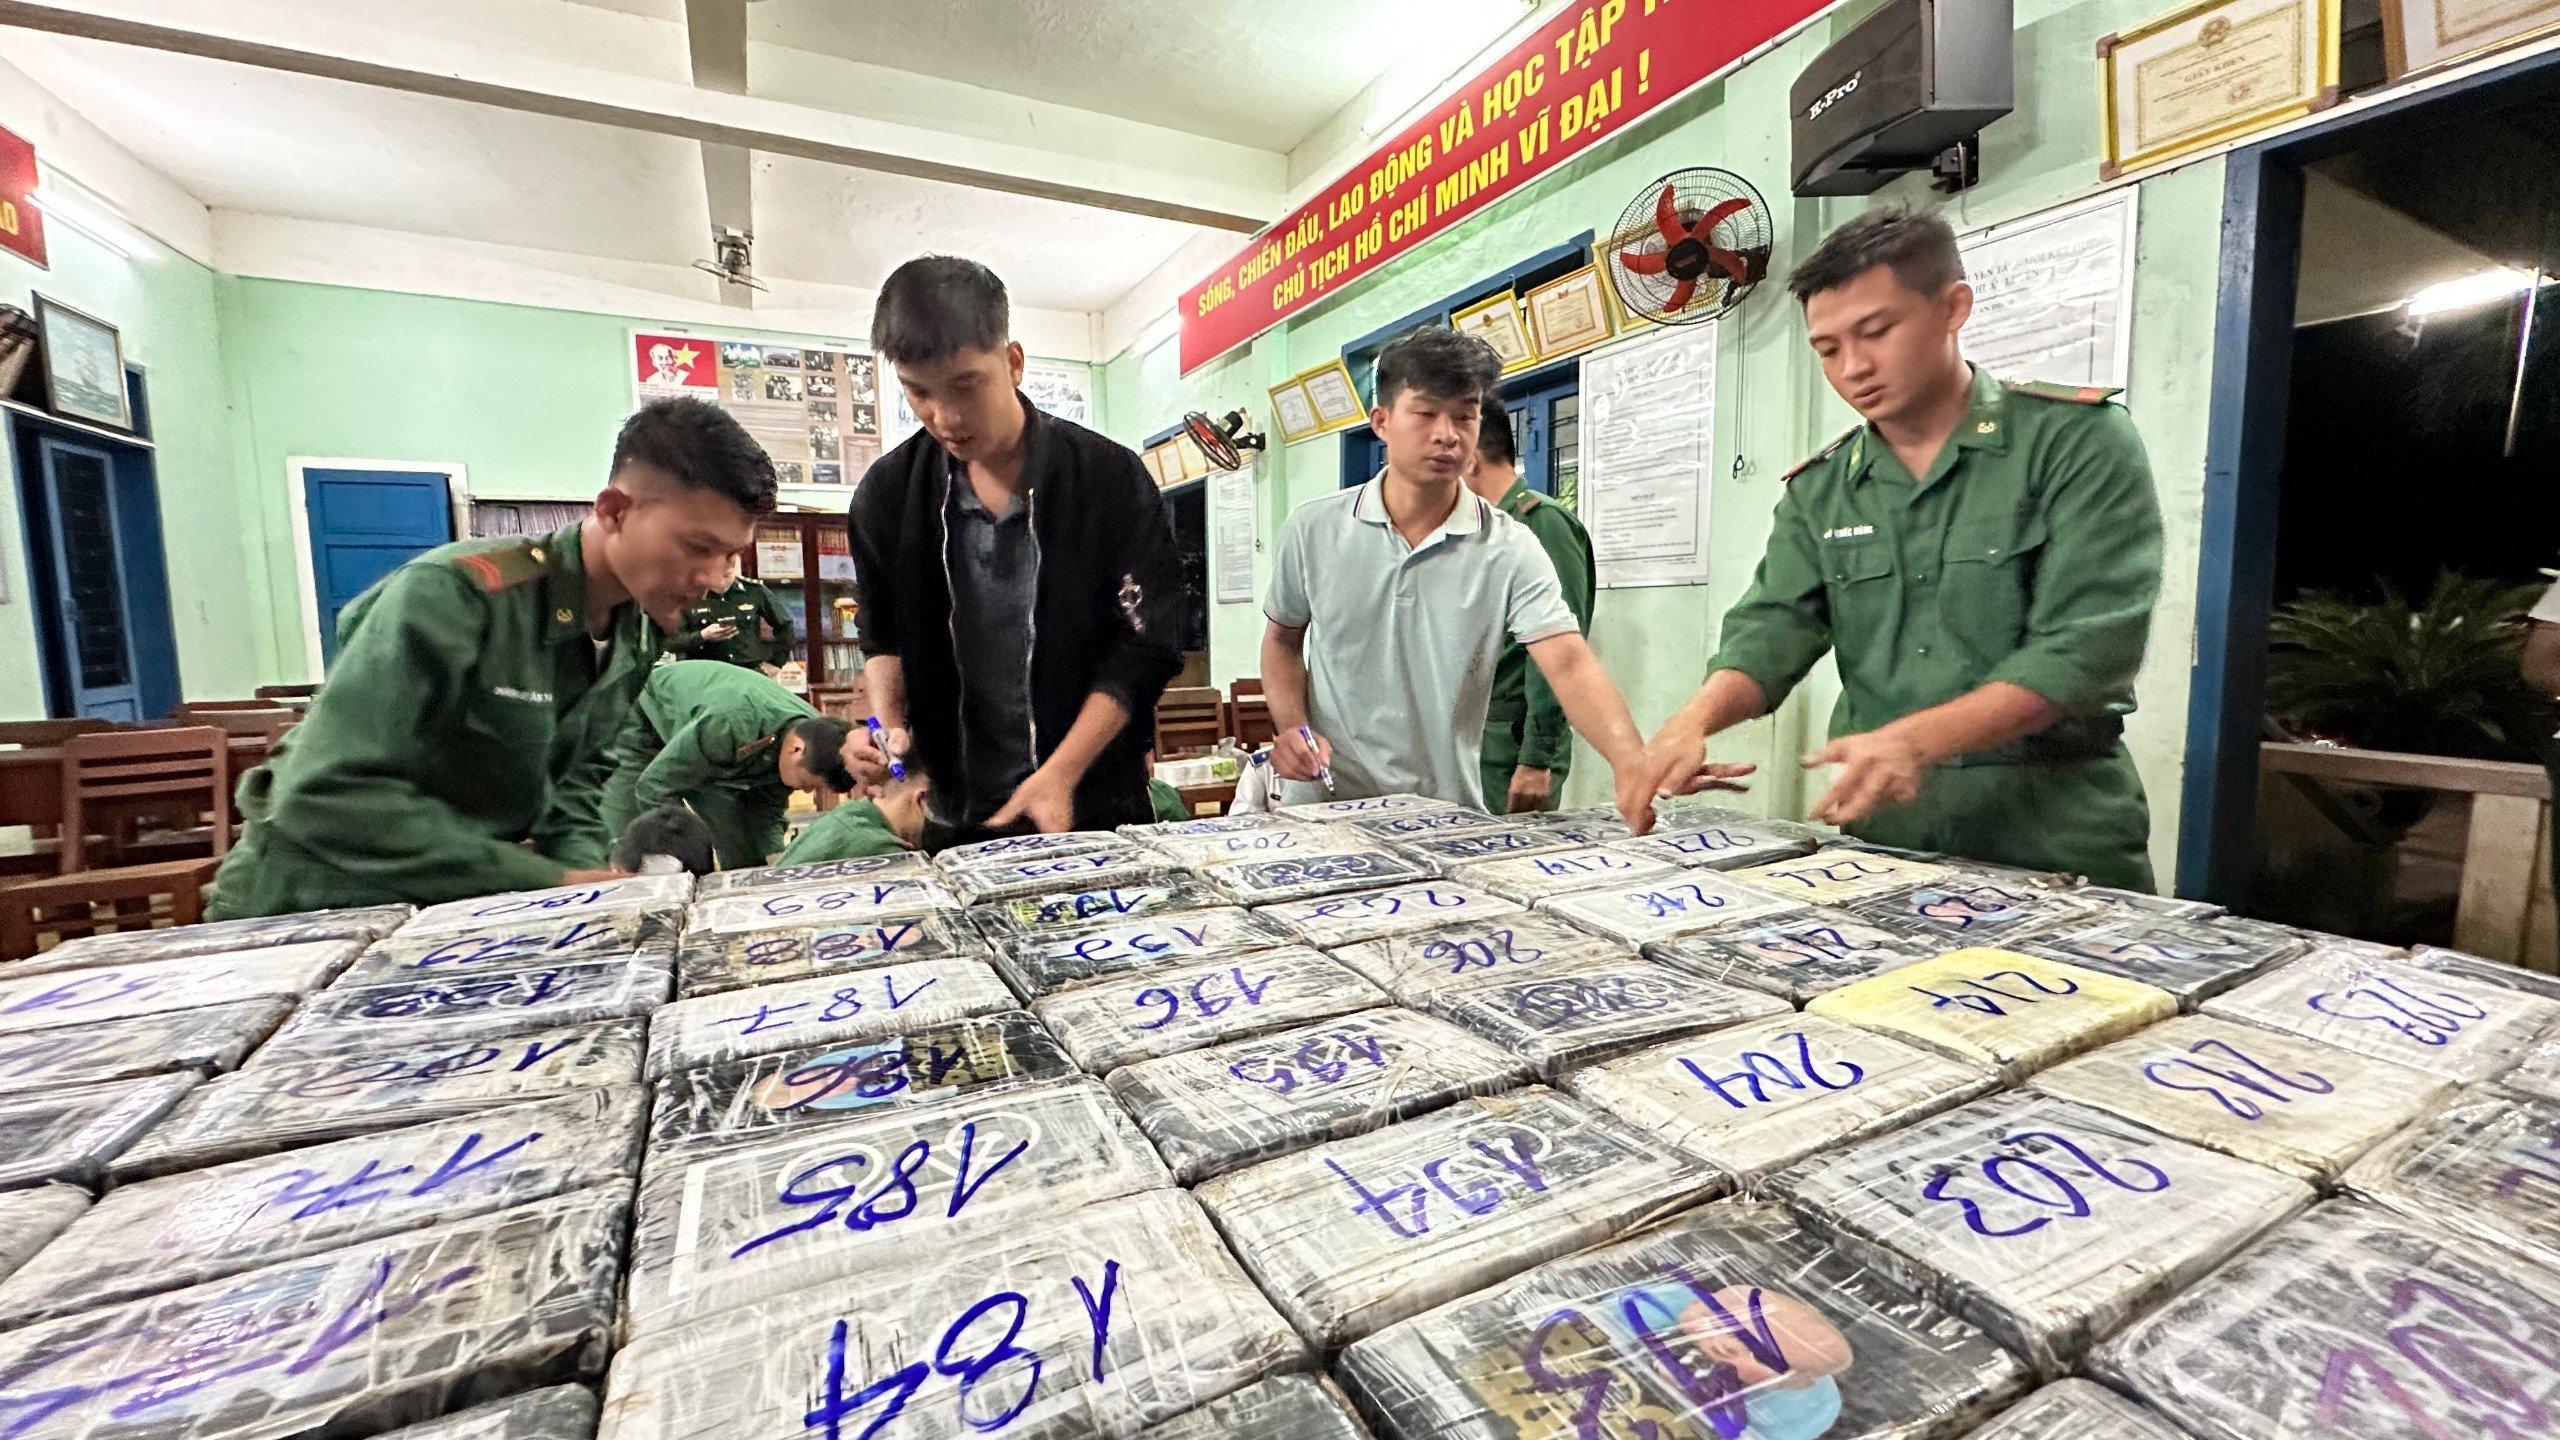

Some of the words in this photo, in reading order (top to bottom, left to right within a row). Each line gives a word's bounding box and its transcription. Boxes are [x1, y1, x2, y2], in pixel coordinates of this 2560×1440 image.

[1809, 78, 1859, 121] K-Pro
[1198, 276, 1236, 318] SỐNG,
[1237, 238, 1282, 291] CHIẾN
[1284, 210, 1324, 260] ĐẤU,
[1328, 183, 1364, 230] LAO
[1369, 133, 1433, 204] ĐỘNG
[1439, 99, 1475, 156] VÀ
[1482, 53, 1545, 129] HỌC
[1554, 0, 1626, 76] TẬP
[1272, 261, 1306, 312] CHỦ
[1308, 241, 1350, 292] TỊCH
[1354, 210, 1383, 265] HỒ
[1388, 184, 1428, 243] CHÍ
[1435, 139, 1510, 218] MINH
[1518, 104, 1552, 166] VĨ
[1559, 66, 1623, 143] ĐẠI
[1638, 48, 1650, 96] !
[762, 884, 897, 918] 189
[744, 923, 915, 967] 188
[1423, 929, 1544, 973] 206
[708, 974, 937, 1035] 187
[1135, 966, 1279, 1030] 196
[1907, 969, 2081, 1017] 214
[784, 1044, 964, 1110] 186
[1229, 1028, 1392, 1095] 195
[1674, 1031, 1865, 1109] 204
[2143, 1038, 2334, 1121] 213
[730, 1122, 1028, 1260] 185
[1325, 1128, 1548, 1239] 194
[1922, 1131, 2171, 1237] 203
[802, 1259, 1120, 1440] 184
